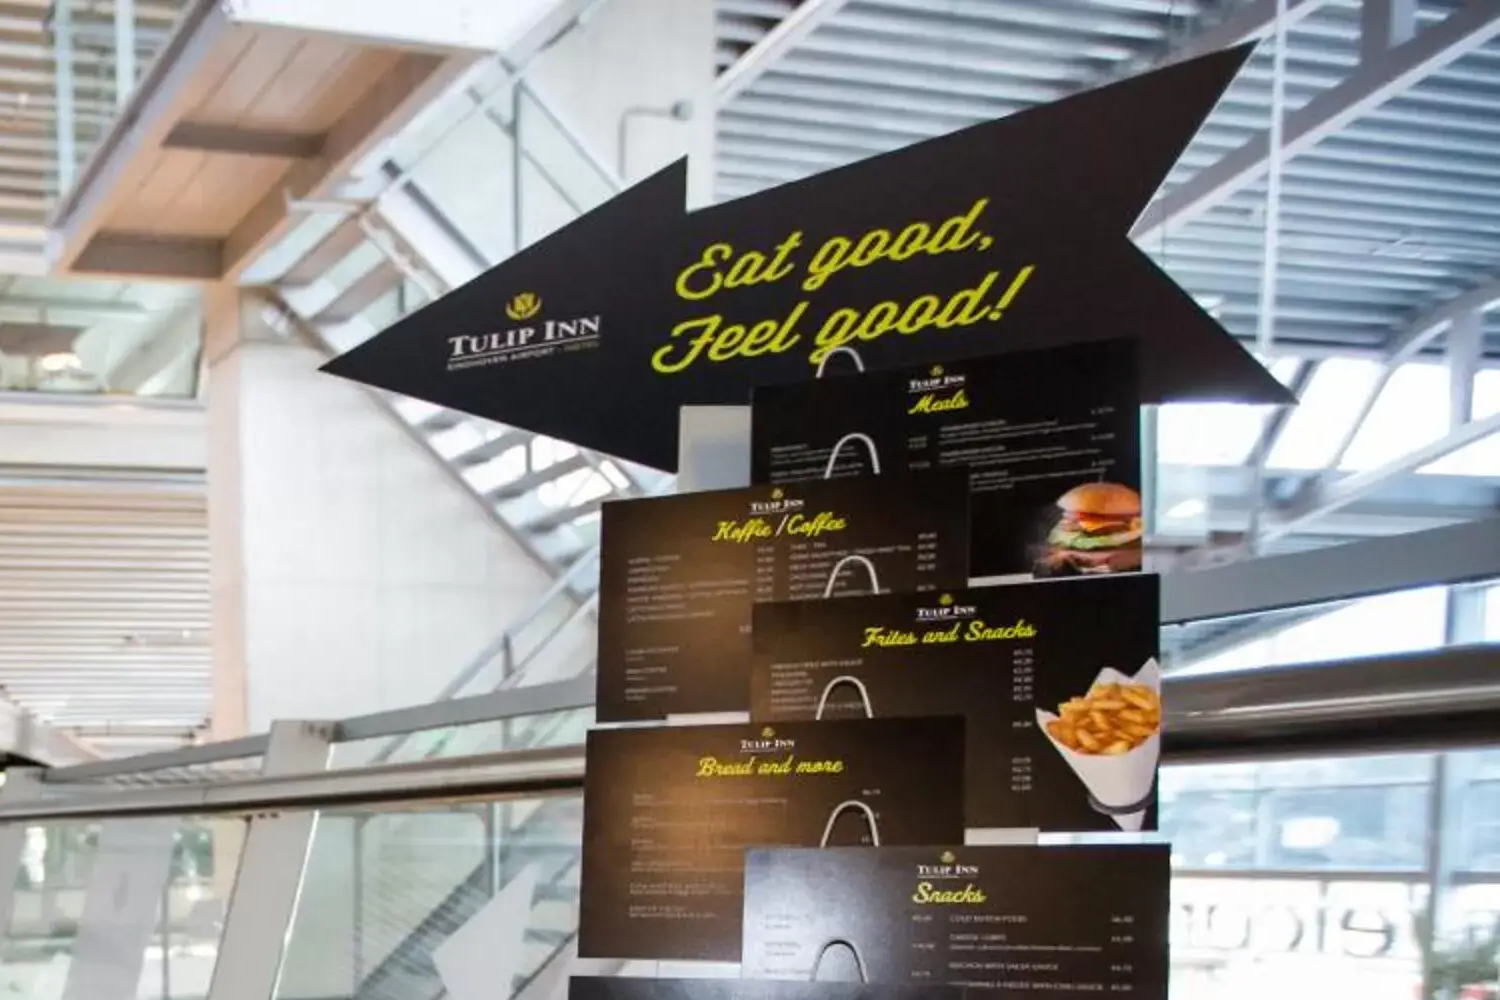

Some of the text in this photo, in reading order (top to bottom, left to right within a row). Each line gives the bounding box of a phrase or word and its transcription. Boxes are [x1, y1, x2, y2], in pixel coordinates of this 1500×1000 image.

[675, 197, 994, 300] Eat good,
[651, 264, 1036, 374] Feel good!
[448, 315, 600, 357] TULIP INN
[908, 389, 969, 415] Meals
[711, 518, 772, 542] Koffie
[861, 619, 1037, 647] Frites and Snacks
[696, 755, 844, 777] Bread and more
[912, 881, 988, 904] Snacks
